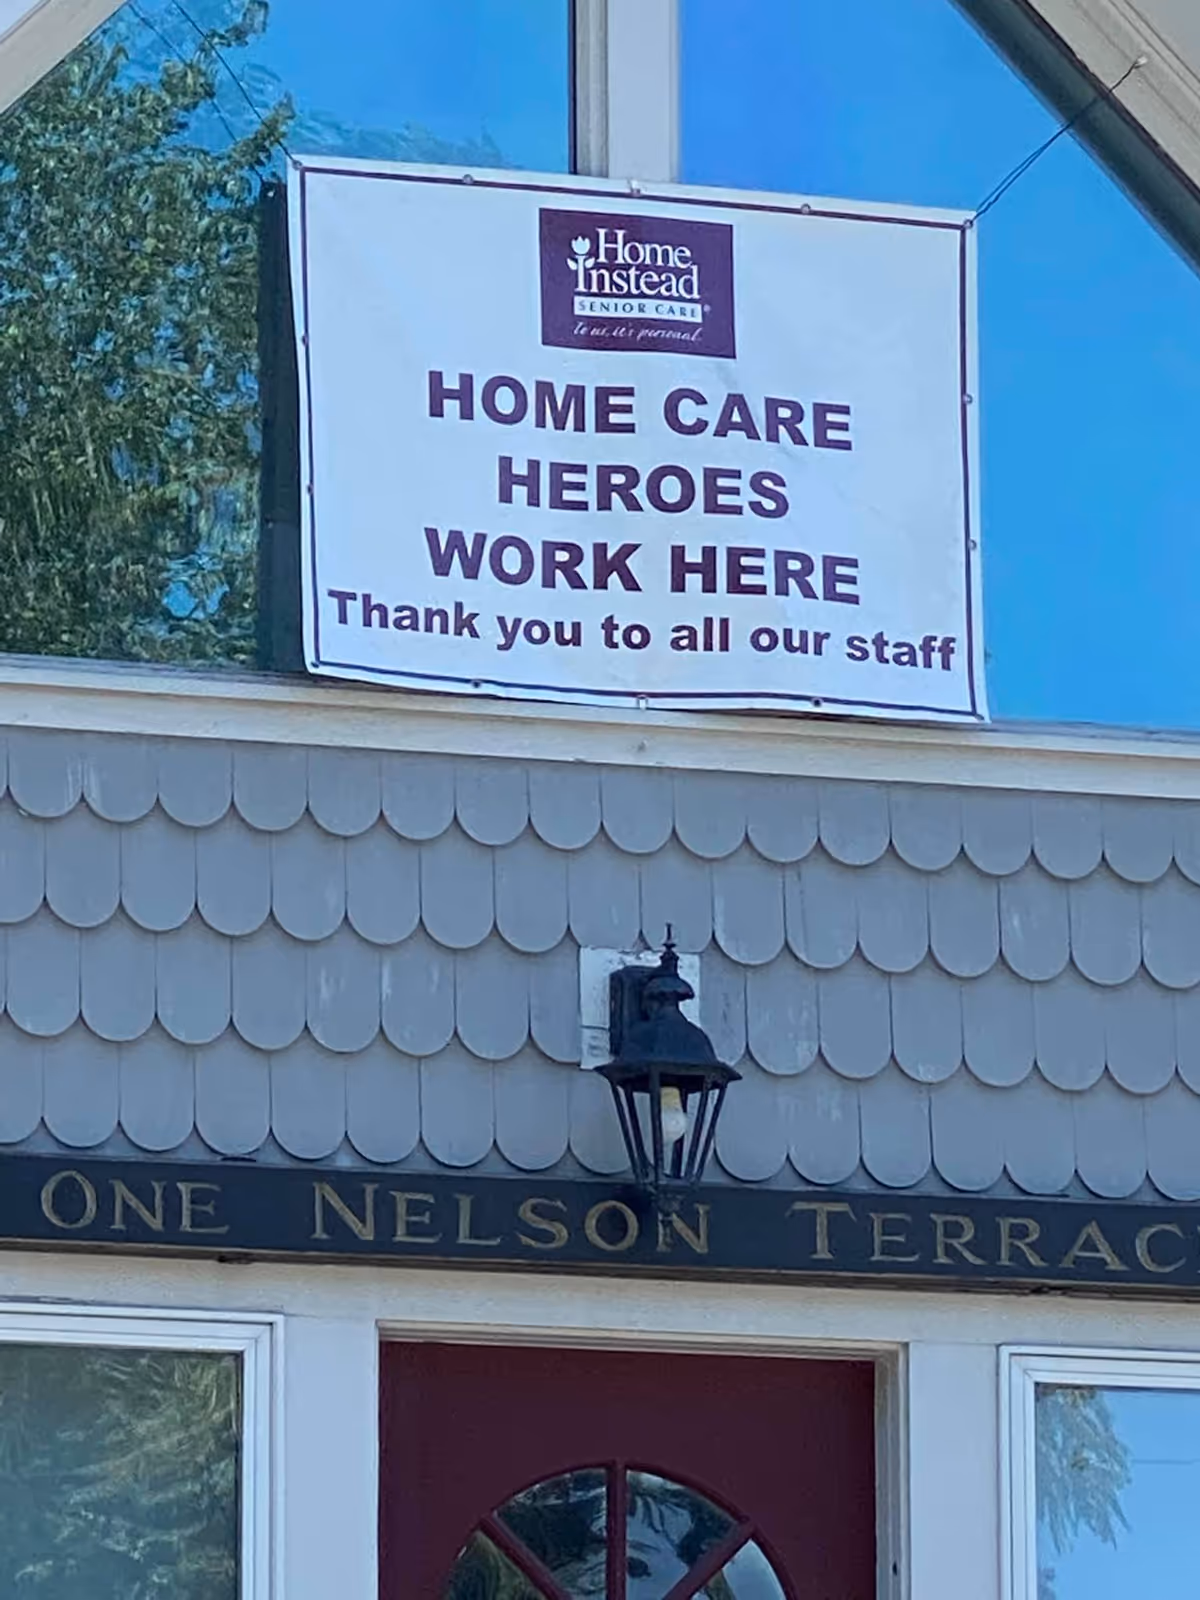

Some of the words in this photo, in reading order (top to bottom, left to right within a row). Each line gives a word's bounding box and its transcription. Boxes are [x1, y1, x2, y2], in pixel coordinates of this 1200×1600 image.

[574, 255, 701, 299] Instead
[596, 227, 692, 269] Home
[578, 300, 646, 313] SENIOR
[654, 304, 697, 318] CARE
[428, 370, 636, 433] HOME
[663, 387, 853, 450] CARE
[498, 455, 790, 518] HEROES
[424, 526, 642, 592] WORK
[670, 544, 860, 605] HERE
[327, 588, 480, 639] Thank
[496, 611, 582, 651] you
[600, 615, 651, 650] to
[670, 615, 730, 653] all
[749, 625, 831, 656] our
[845, 634, 956, 671] staff
[40, 1169, 230, 1235] ONE
[310, 1181, 711, 1256] NELSON
[785, 1200, 1200, 1275] TERRAC
